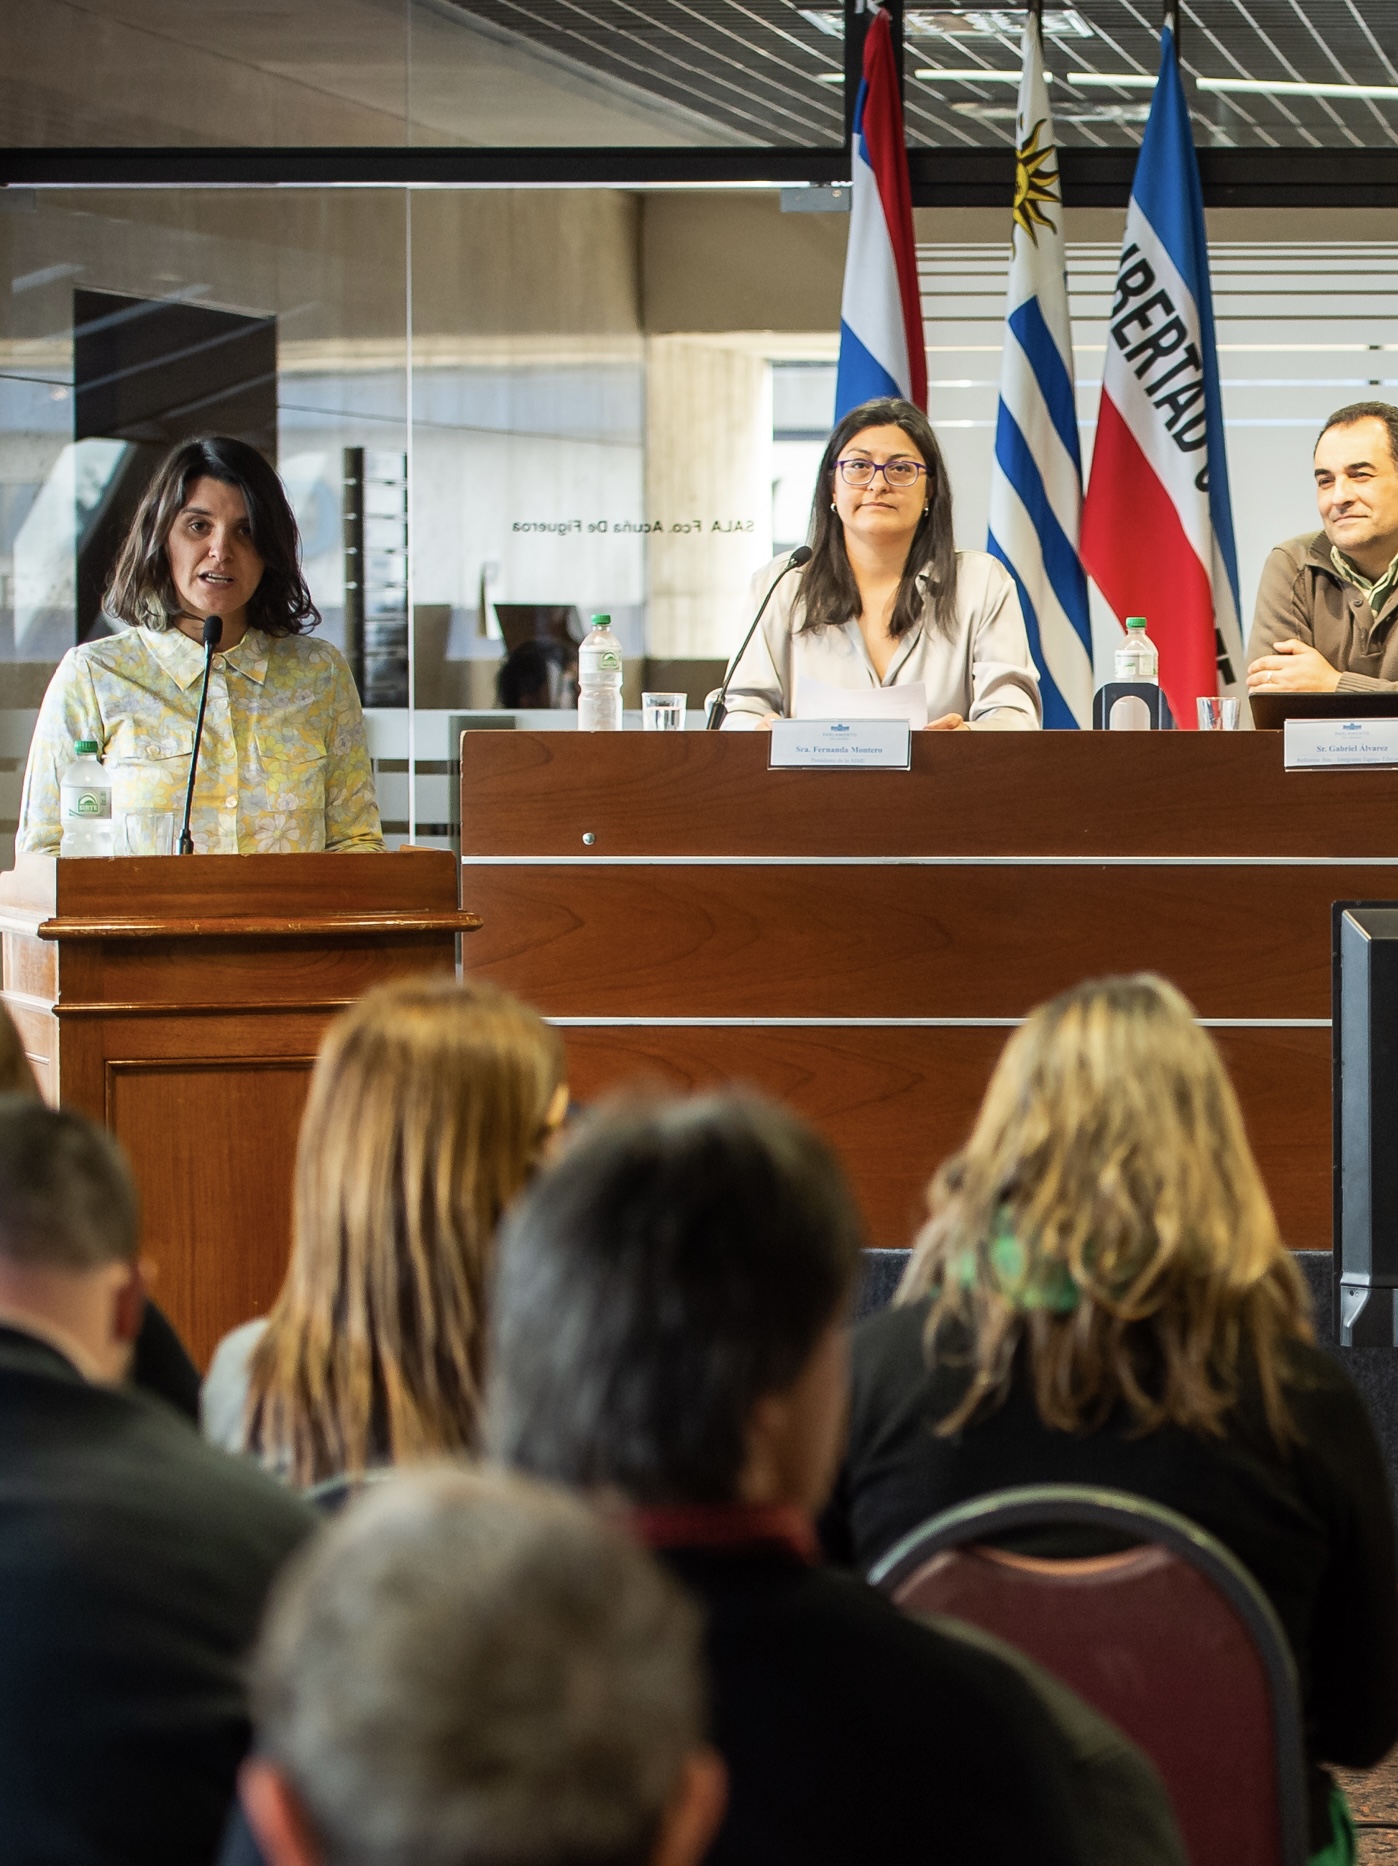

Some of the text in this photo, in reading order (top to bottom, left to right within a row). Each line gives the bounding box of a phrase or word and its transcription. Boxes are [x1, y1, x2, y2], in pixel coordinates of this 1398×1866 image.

[796, 745, 883, 754] Sra. Fernanda Montero
[1359, 743, 1389, 752] Álvarez
